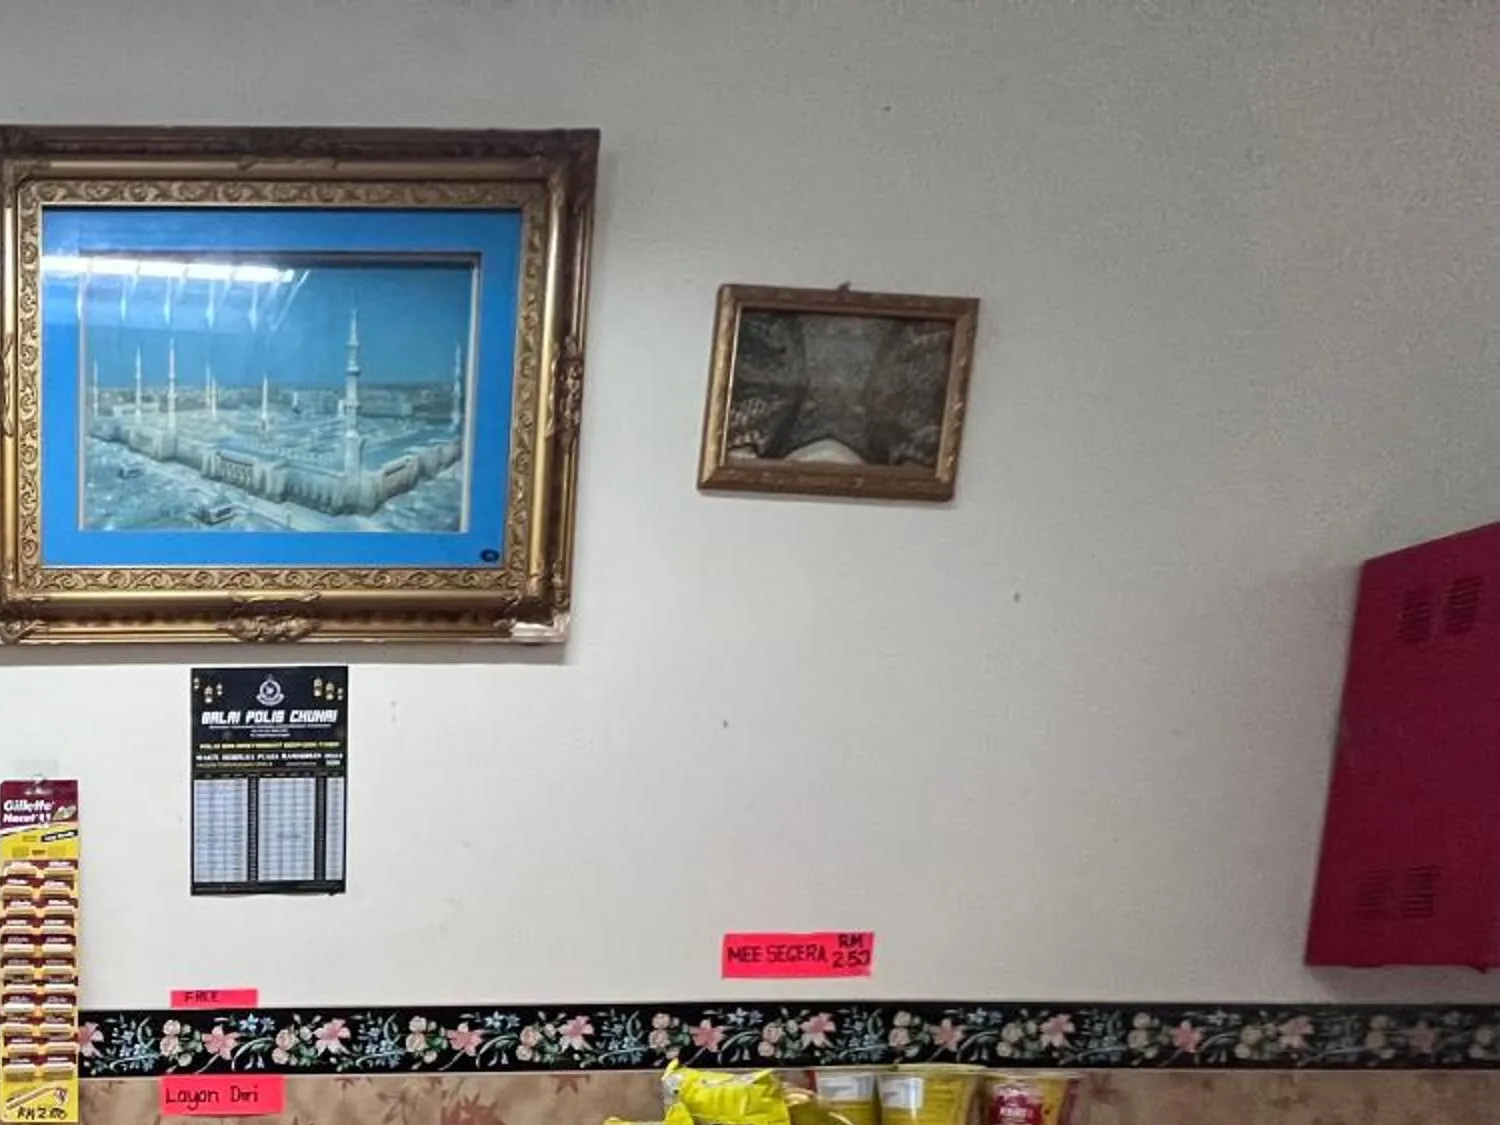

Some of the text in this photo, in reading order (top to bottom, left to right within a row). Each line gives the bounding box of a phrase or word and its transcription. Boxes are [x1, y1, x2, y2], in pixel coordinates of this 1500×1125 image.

[245, 709, 285, 724] POLIS
[3, 799, 53, 812] Gillette
[838, 933, 863, 948] RM
[727, 944, 828, 963] MEE SEGERA
[165, 1088, 219, 1111] Layan
